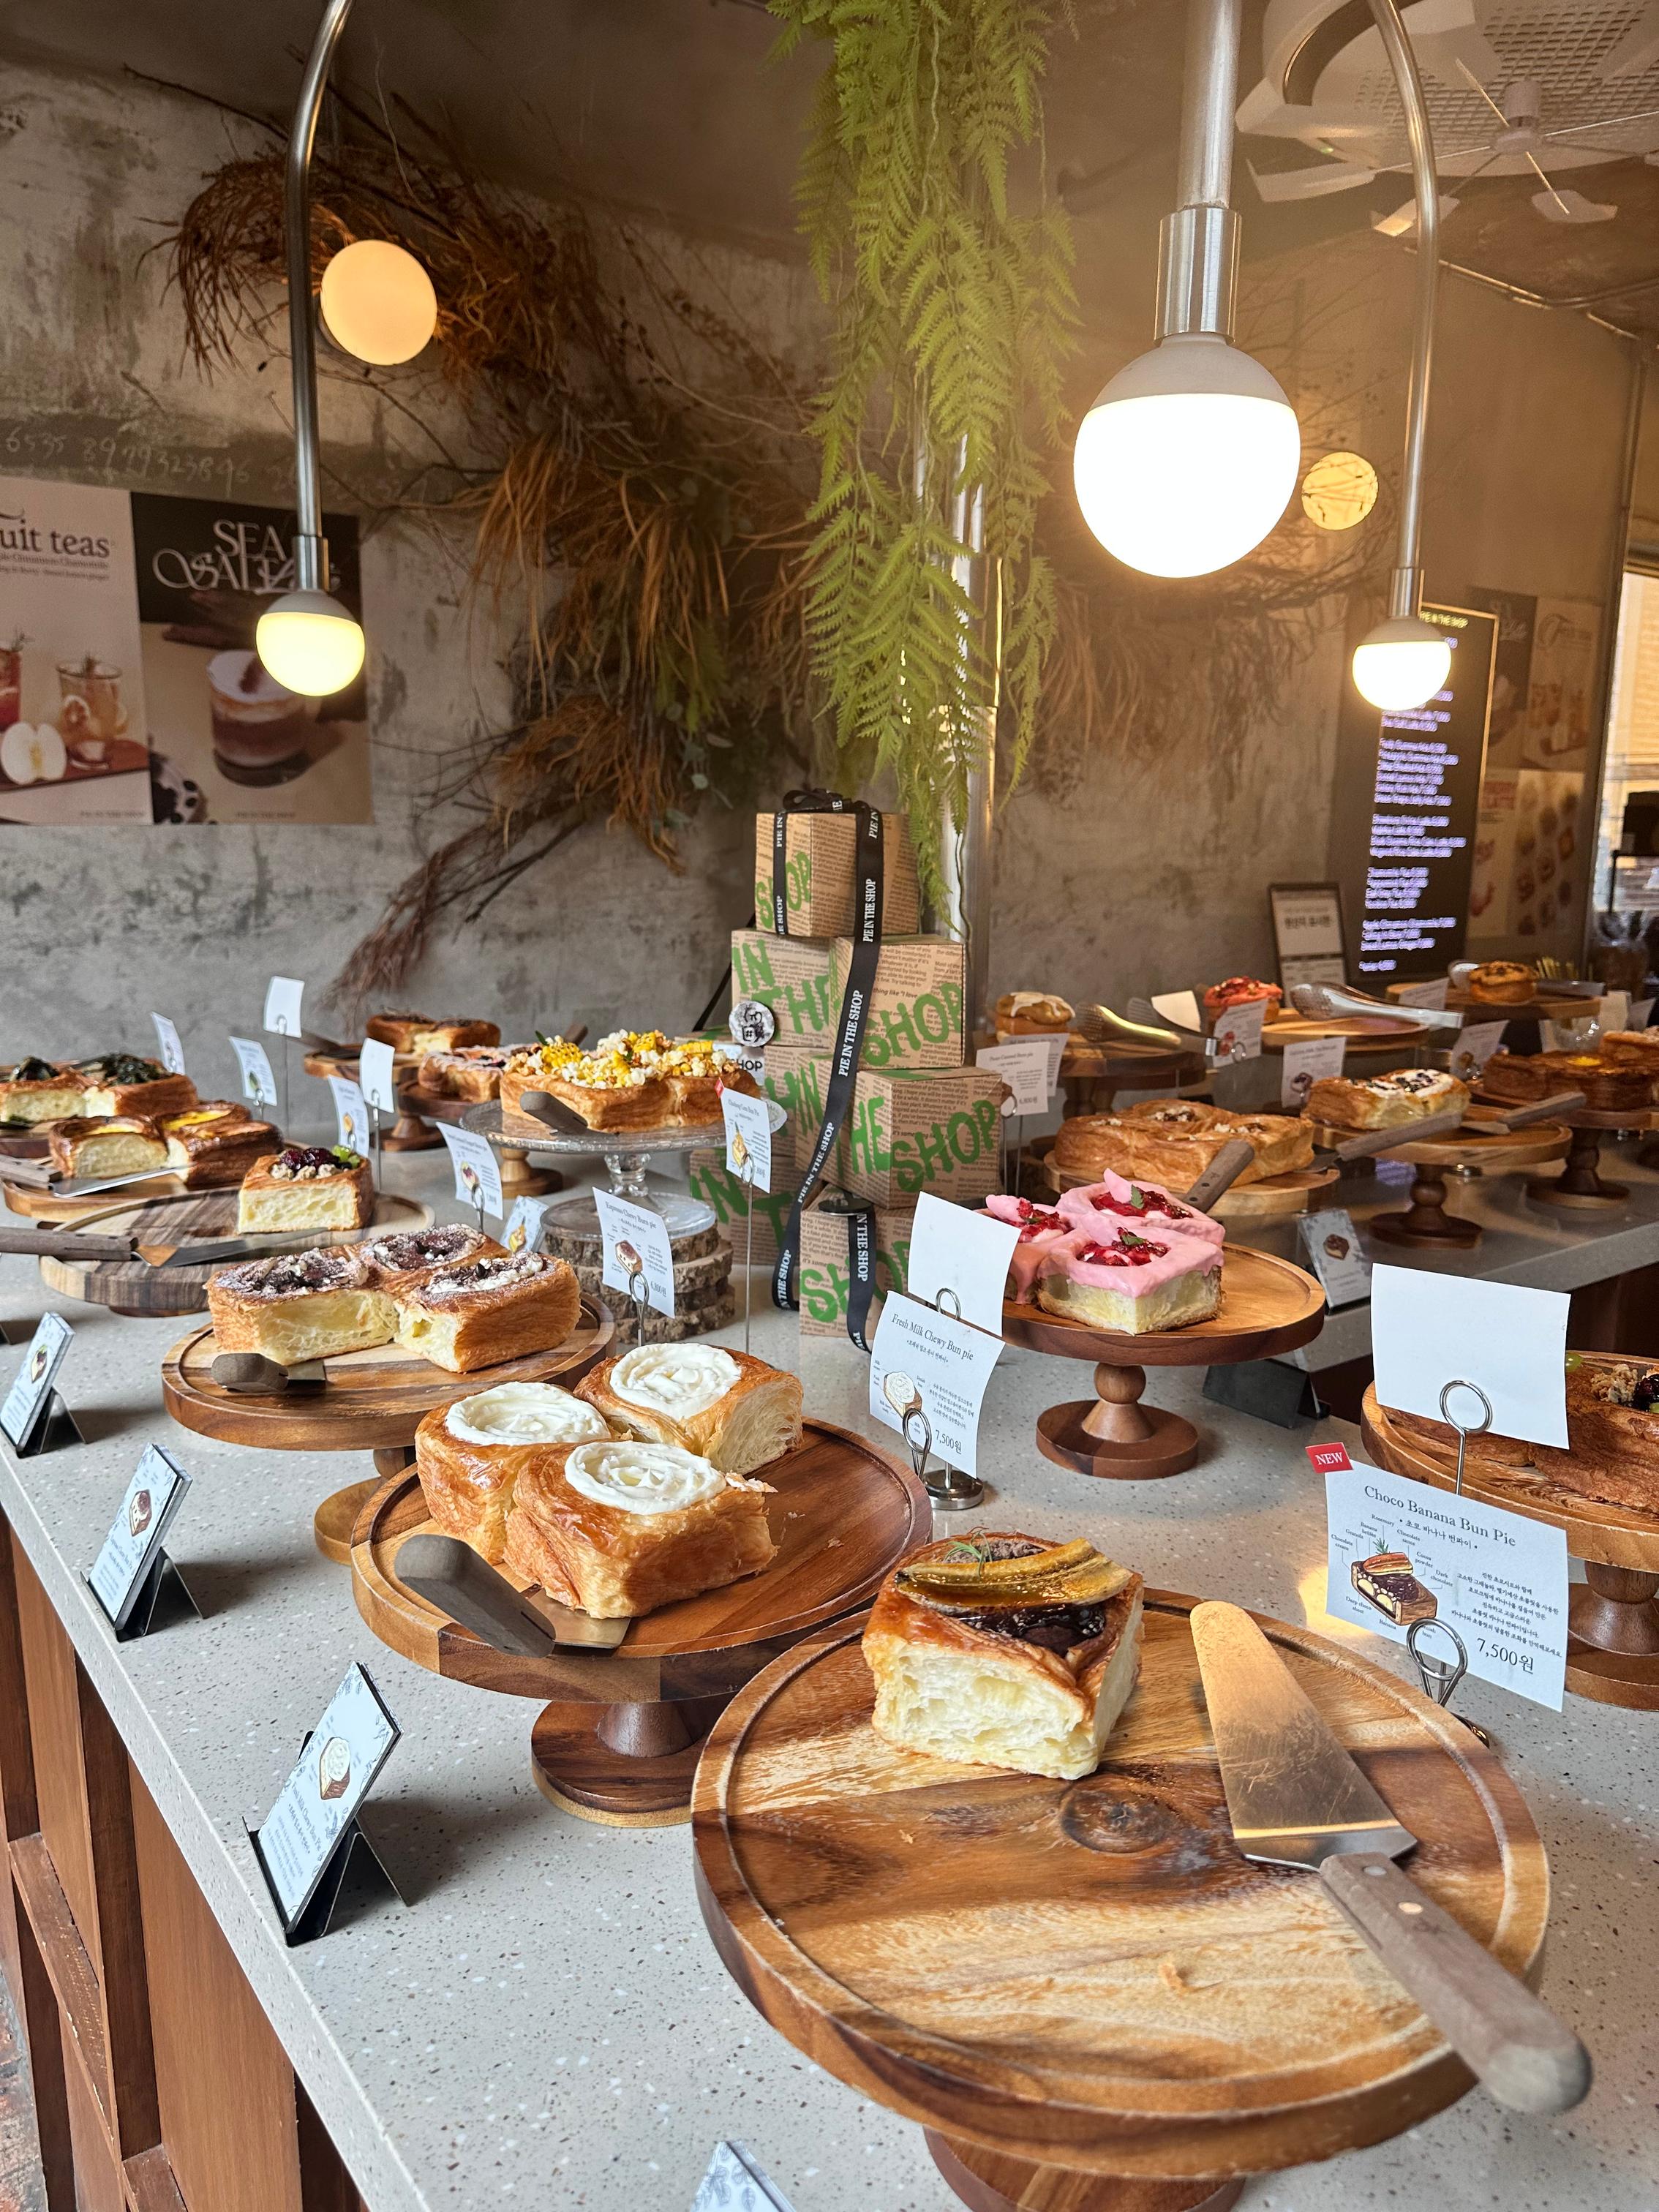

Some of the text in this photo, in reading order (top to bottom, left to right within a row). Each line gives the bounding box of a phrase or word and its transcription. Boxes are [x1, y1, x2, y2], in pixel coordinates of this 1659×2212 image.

[0, 518, 110, 558] uit teas
[213, 519, 286, 561] SEA
[777, 816, 783, 828] IN
[863, 879, 876, 942] PIE IN THE SHOP
[732, 939, 774, 993] IN
[838, 990, 864, 1077] PIE IN THE SHOP
[735, 1059, 762, 1071] HOP
[891, 1100, 996, 1193] SHOP
[798, 1122, 834, 1203] PIE IN THE SHOP
[857, 1225, 868, 1249] THE
[778, 1249, 791, 1280] SHOP
[858, 1250, 868, 1282] SHOP
[778, 1279, 787, 1300] THE
[892, 1314, 974, 1360] Fresh Milk Chewy Bun pie
[936, 1429, 961, 1454] 7,500원
[1316, 1452, 1343, 1465] NEW
[1364, 1485, 1516, 1546] Choco Banana Bun Pie
[1331, 1533, 1353, 1546] Chocolate
[1396, 1529, 1421, 1541] Chocolate
[1405, 1519, 1472, 1549] 초코 바나나 번파이
[1430, 1575, 1453, 1587] chocolate
[1435, 1569, 1448, 1579] Dark
[1457, 1573, 1472, 1583] 고소한
[1451, 1609, 1471, 1622] 바나나와
[1489, 1614, 1505, 1625] 바나나
[1477, 1637, 1534, 1674] 7,500원
